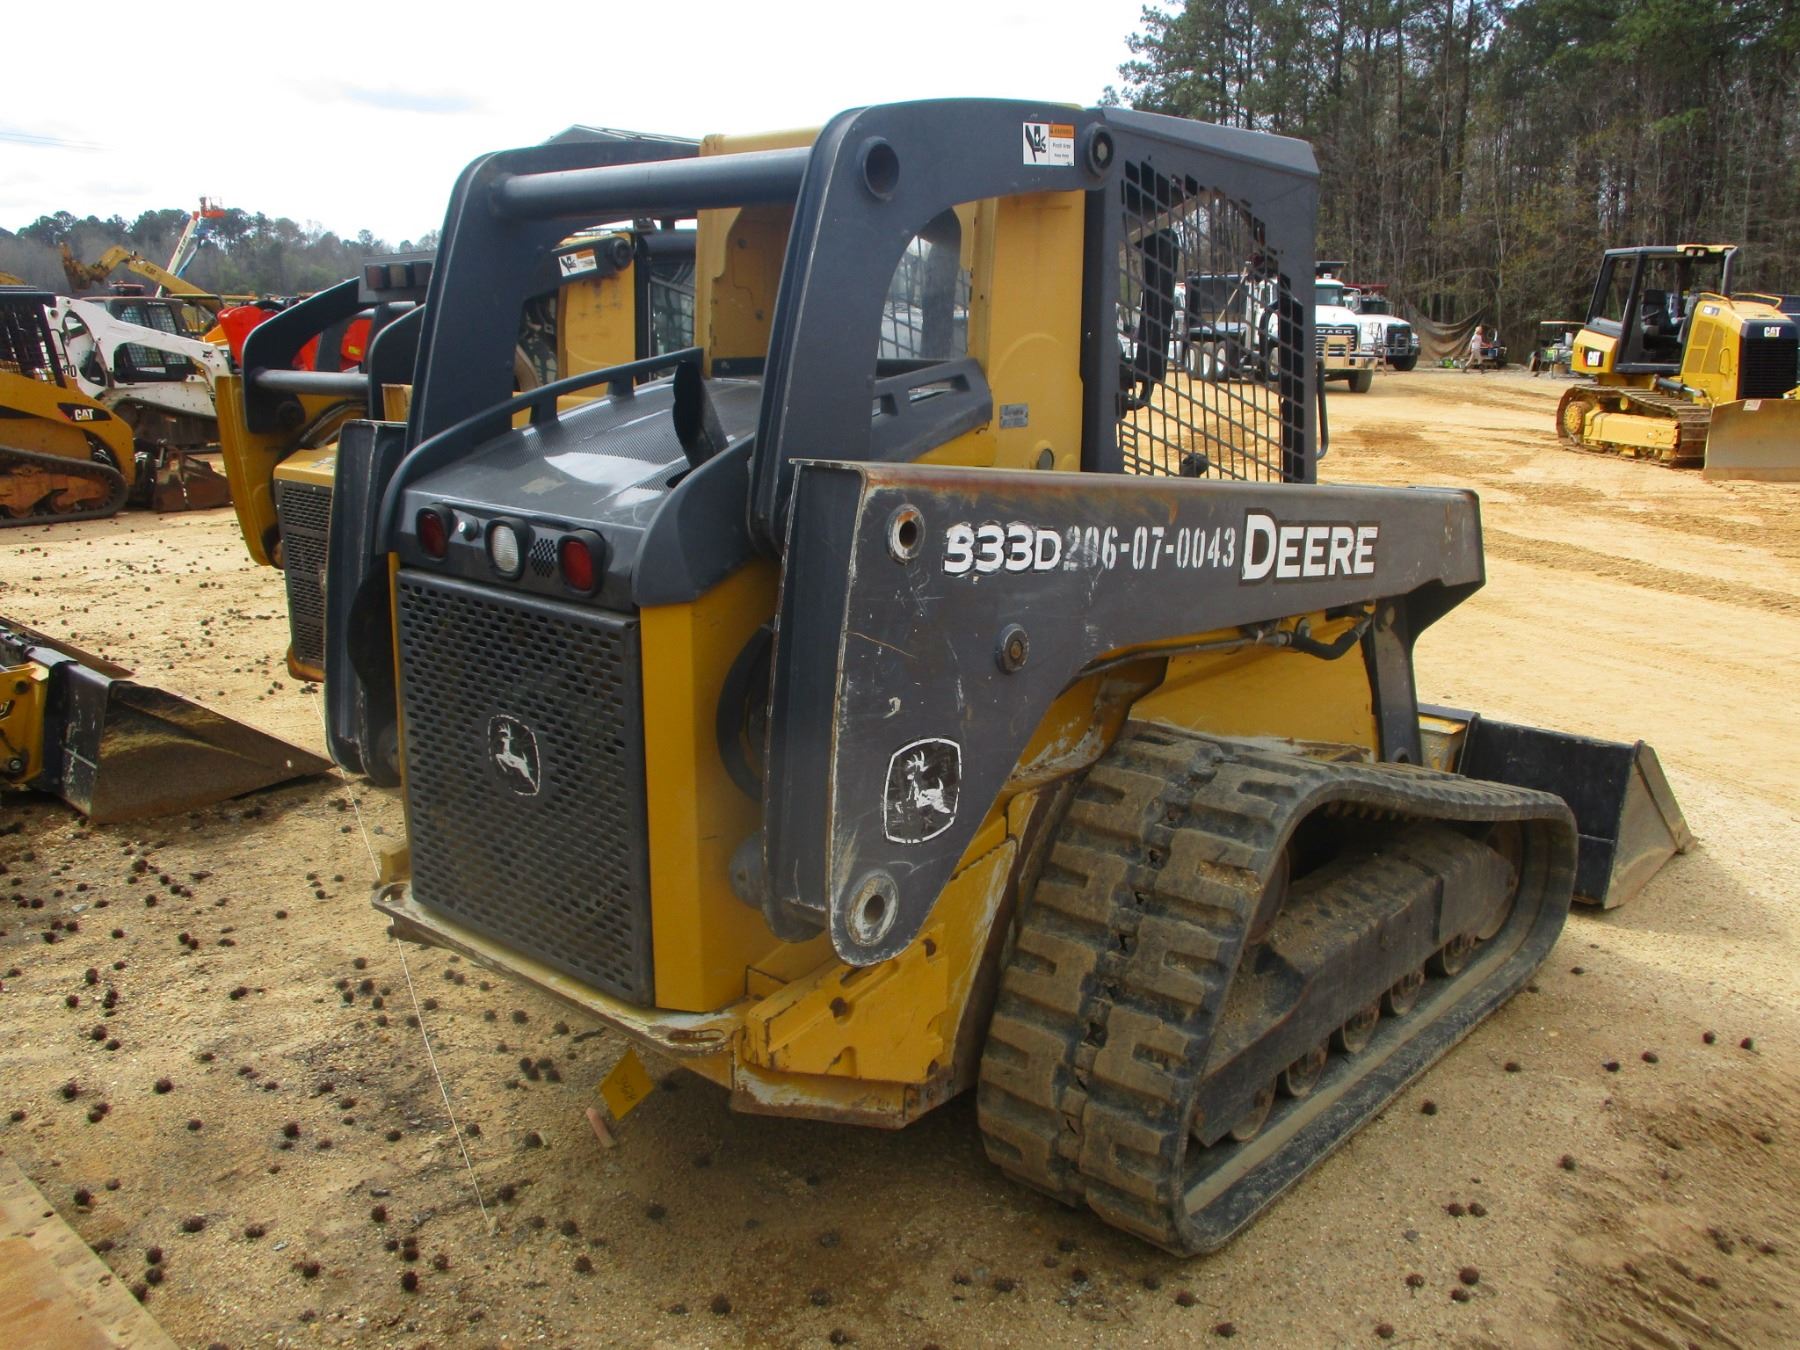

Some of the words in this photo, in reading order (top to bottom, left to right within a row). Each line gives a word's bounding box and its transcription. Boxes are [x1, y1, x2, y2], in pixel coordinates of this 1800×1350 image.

[1763, 326, 1781, 338] CAT
[1587, 351, 1600, 366] CAT
[74, 408, 94, 421] CAT
[1063, 525, 1236, 571] 206-07-0043
[1241, 514, 1379, 580] DEERE
